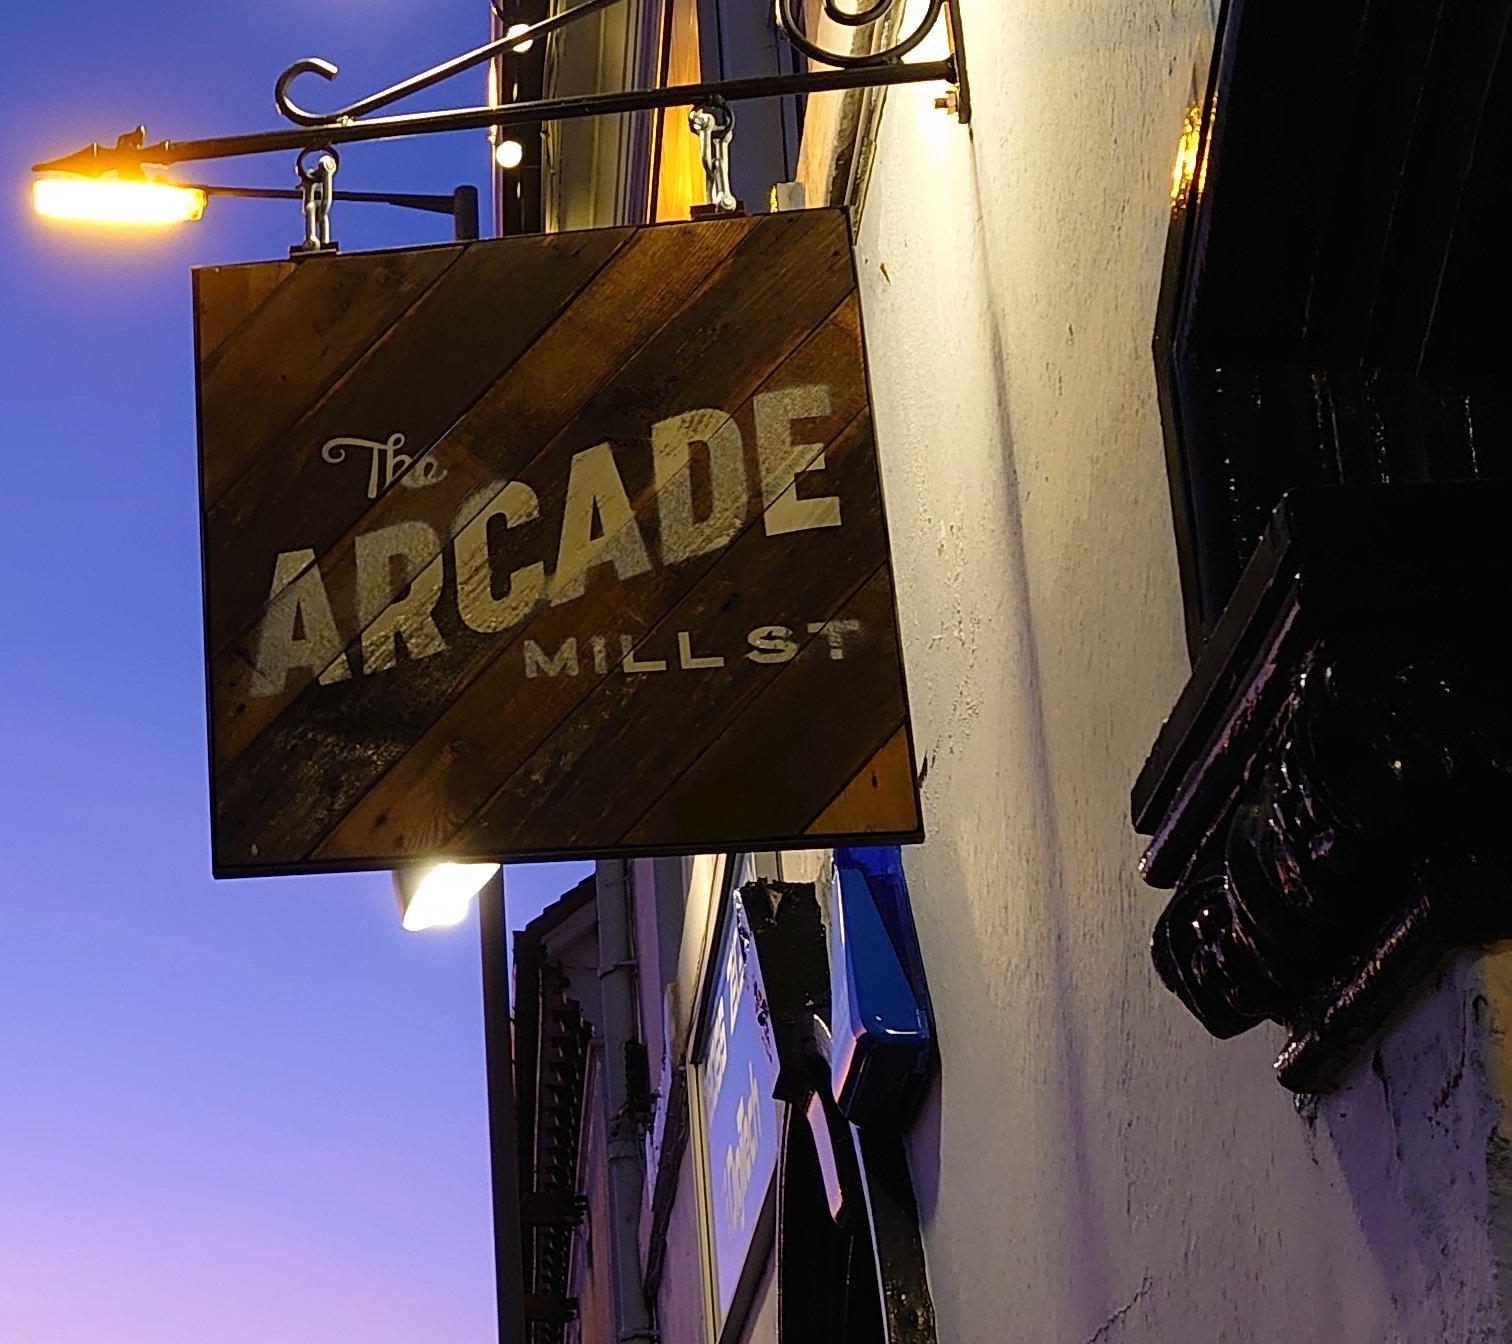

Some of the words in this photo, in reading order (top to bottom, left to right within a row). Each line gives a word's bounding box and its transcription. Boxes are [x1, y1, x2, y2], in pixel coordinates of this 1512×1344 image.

[321, 433, 448, 499] The
[248, 385, 843, 699] ARCADE
[523, 629, 725, 680] MILL
[746, 619, 861, 666] ST
